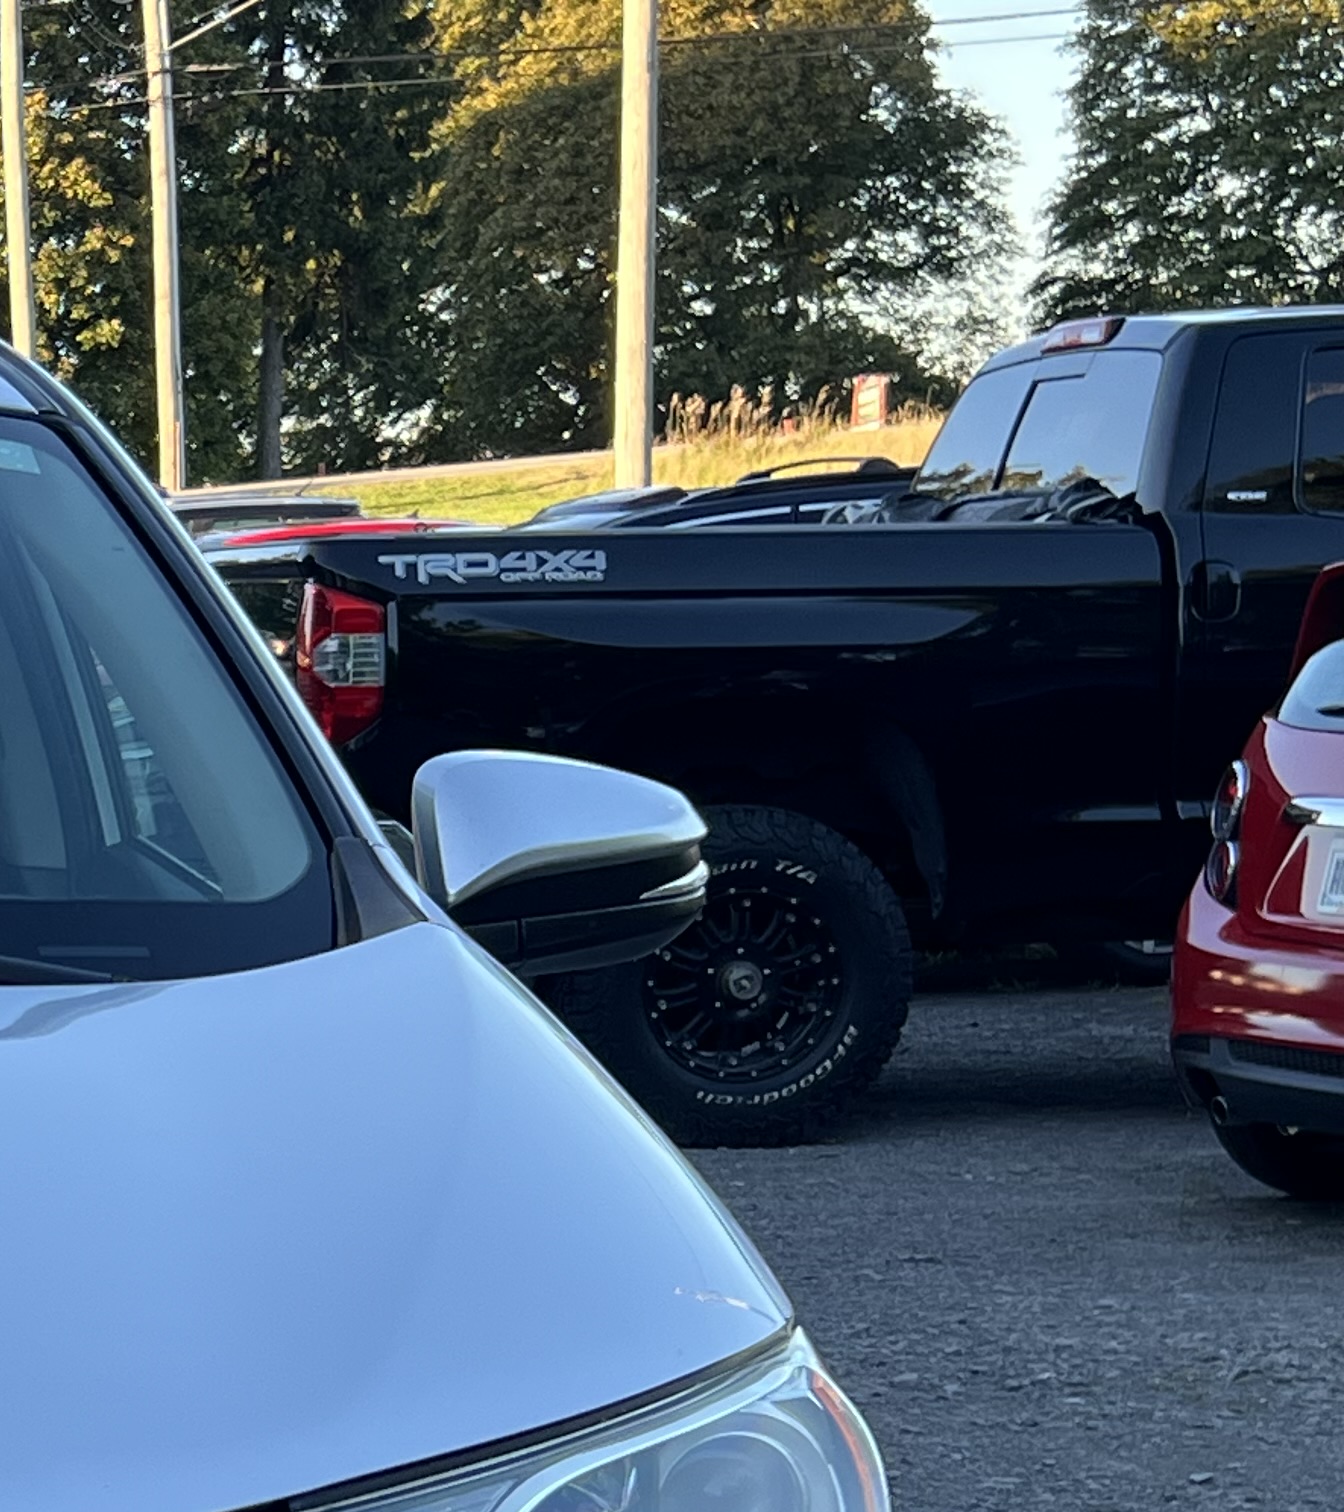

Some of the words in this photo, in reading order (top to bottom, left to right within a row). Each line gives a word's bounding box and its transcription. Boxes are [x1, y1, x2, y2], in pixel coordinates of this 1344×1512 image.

[377, 552, 500, 585] TRD
[500, 571, 542, 583] OFF
[545, 570, 605, 583] ROAD
